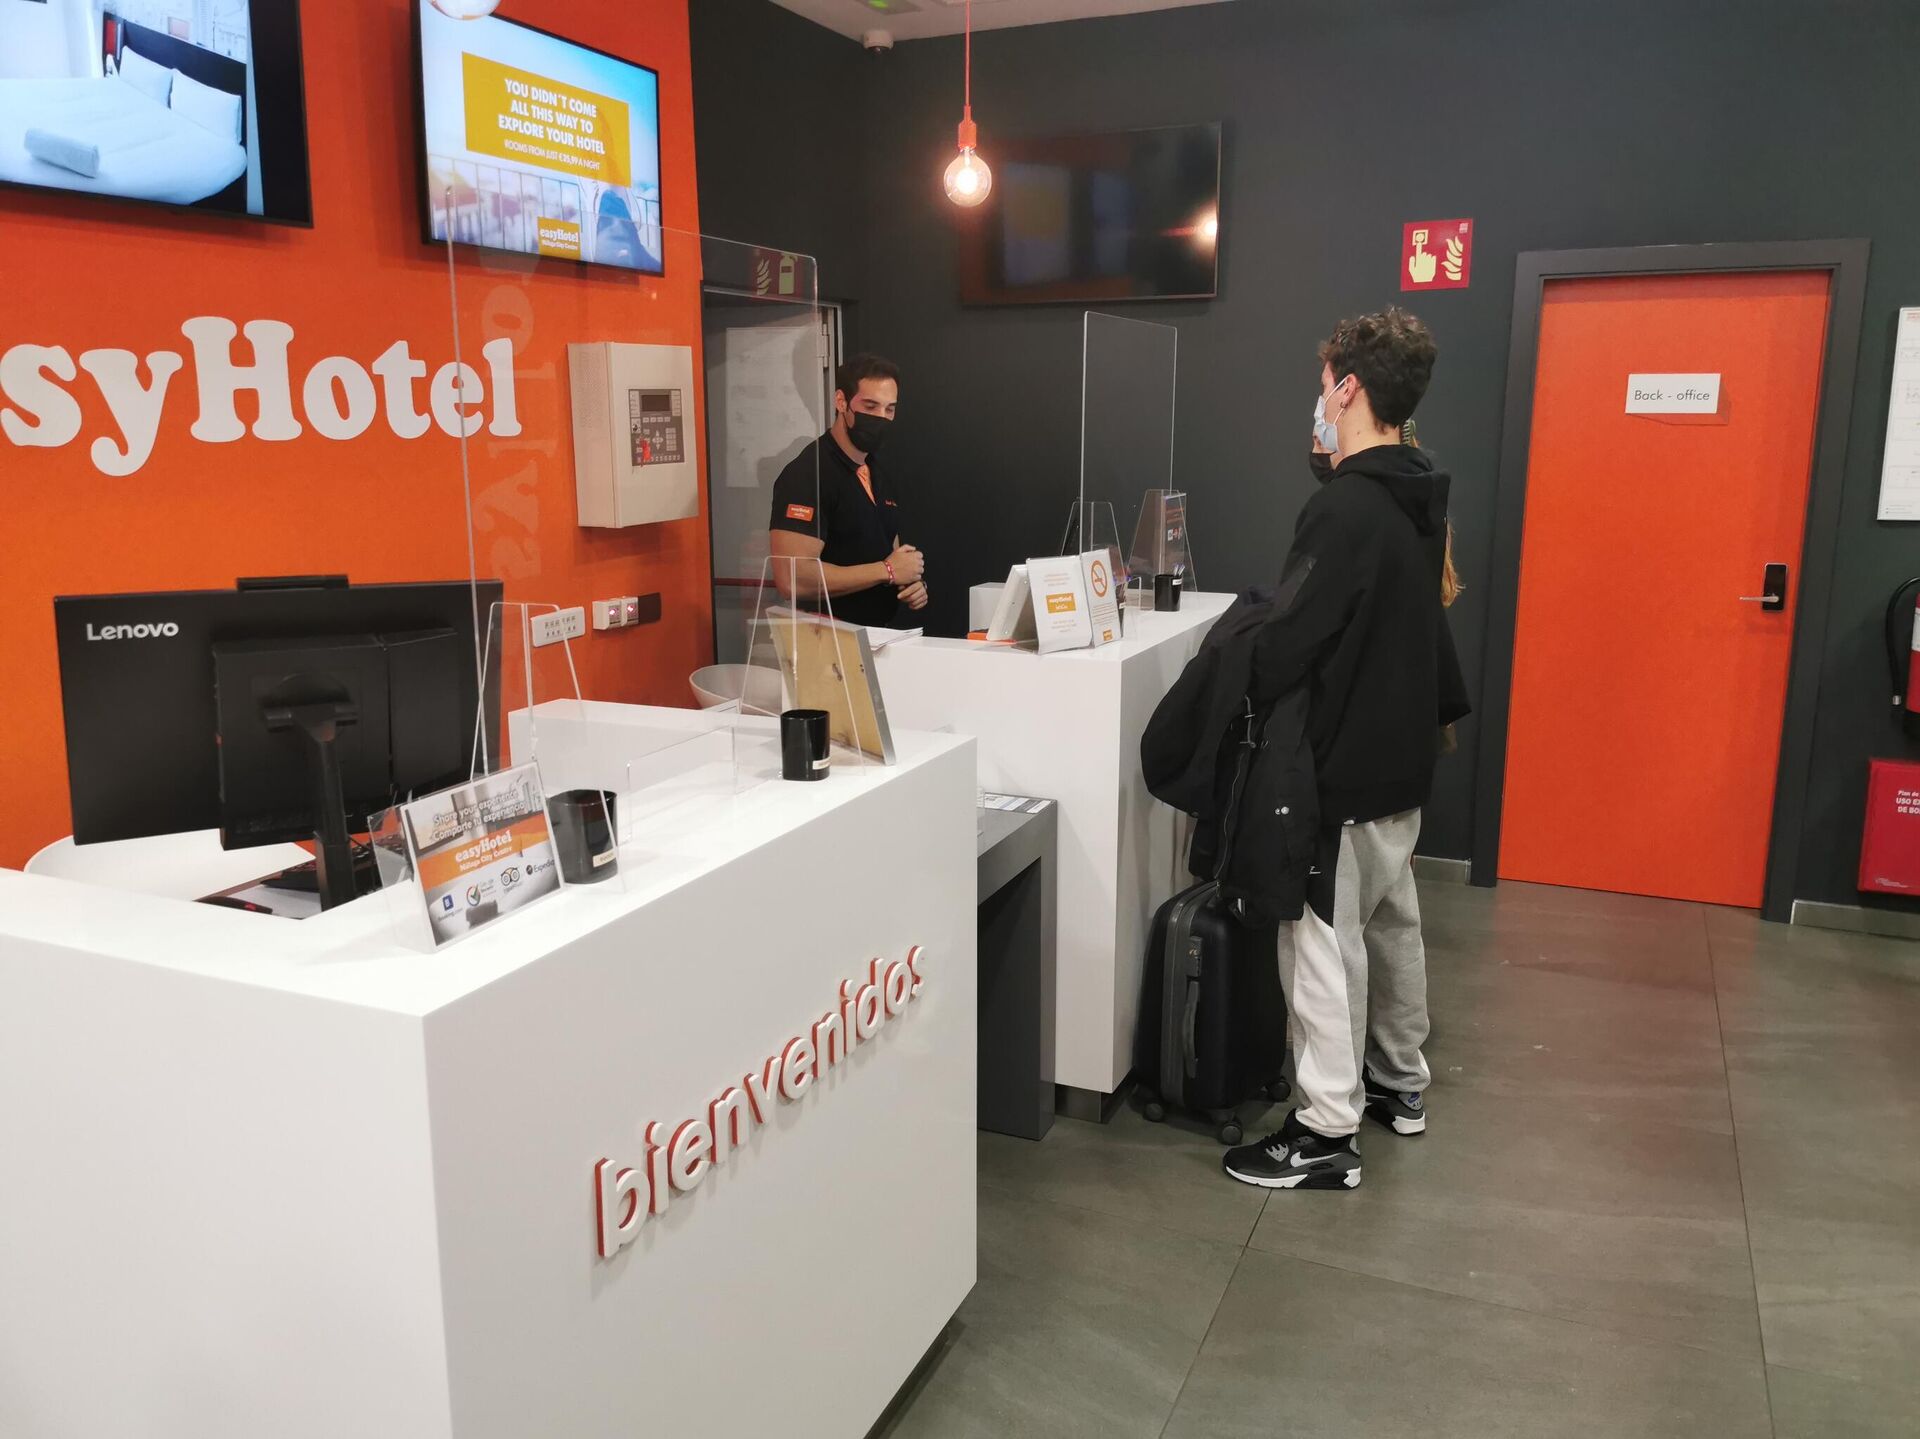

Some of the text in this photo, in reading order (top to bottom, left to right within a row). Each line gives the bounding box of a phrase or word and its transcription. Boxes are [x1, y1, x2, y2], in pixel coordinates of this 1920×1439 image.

[504, 78, 528, 98] YOU
[569, 97, 597, 118] COME
[510, 100, 594, 134] ALL THIS WAY TO
[498, 114, 605, 155] EXPLORE YOUR HOTEL
[504, 139, 528, 153] ROOMS
[528, 145, 546, 157] FROM
[546, 150, 558, 160] JUST
[584, 159, 600, 170] NIGHT
[540, 229, 579, 242] easyHotel
[0, 316, 522, 476] syHotel
[1634, 389, 1663, 401] Back
[1676, 389, 1710, 401] office
[86, 622, 179, 641] Lenovo
[433, 802, 525, 841] Comparte tu experiencia
[434, 789, 519, 826] Share your experience
[455, 829, 513, 862] easyHotel
[480, 853, 493, 863] City
[533, 858, 556, 873] Expedia
[594, 944, 928, 1258] bienvenidos
